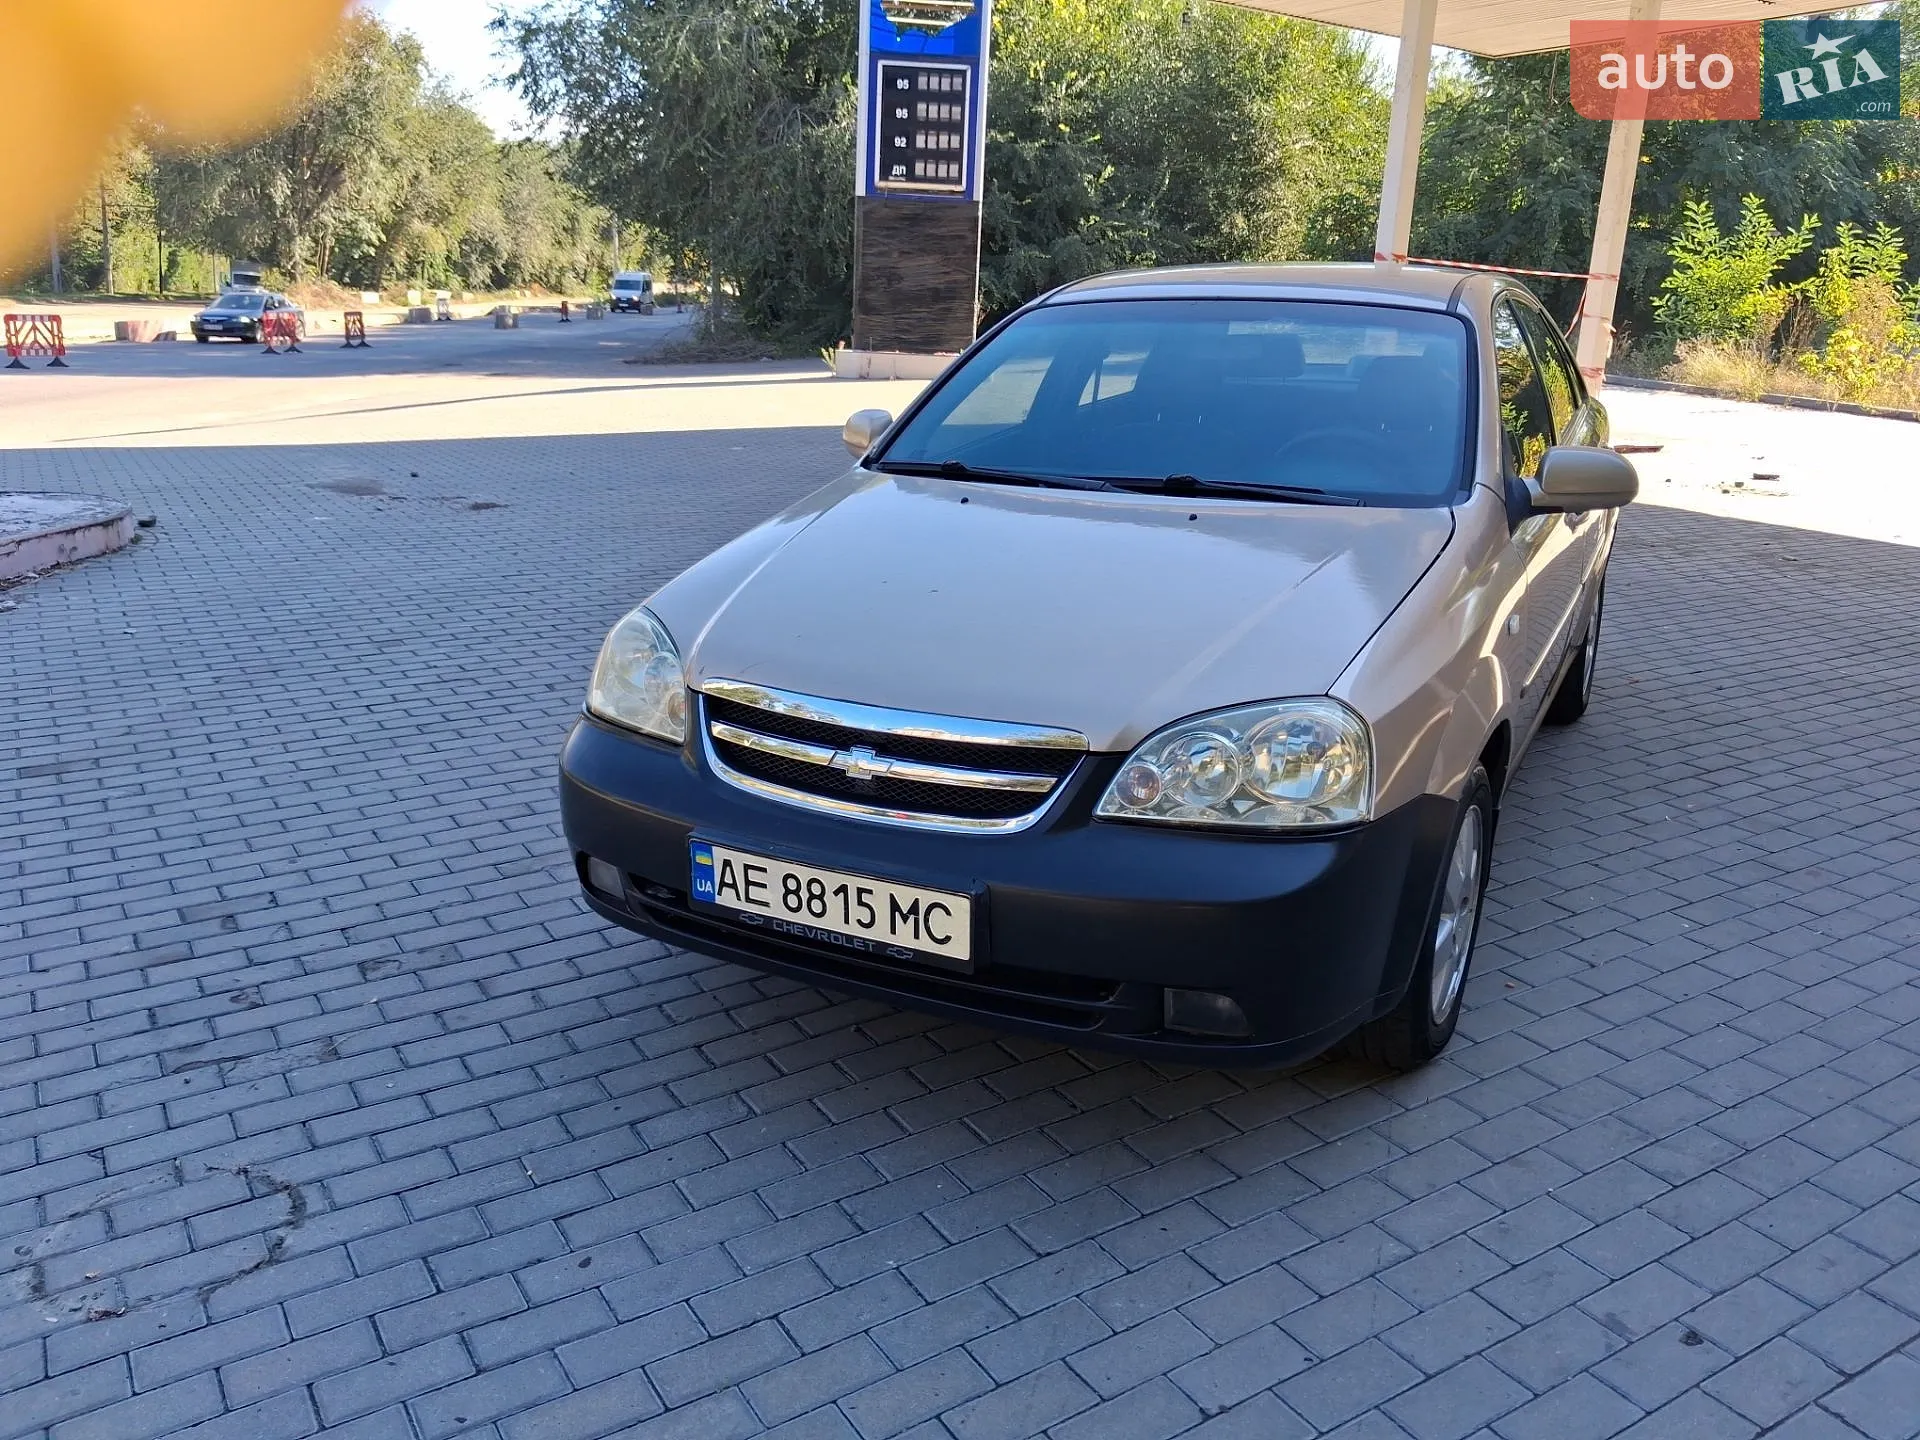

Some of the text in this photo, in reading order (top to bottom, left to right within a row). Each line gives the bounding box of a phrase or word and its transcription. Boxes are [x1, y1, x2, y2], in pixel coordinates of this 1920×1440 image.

[895, 107, 908, 119] 95
[894, 136, 907, 148] 92
[696, 878, 714, 894] UA
[716, 858, 953, 945] AE 8815 MC
[773, 920, 876, 952] CHEVROLET
